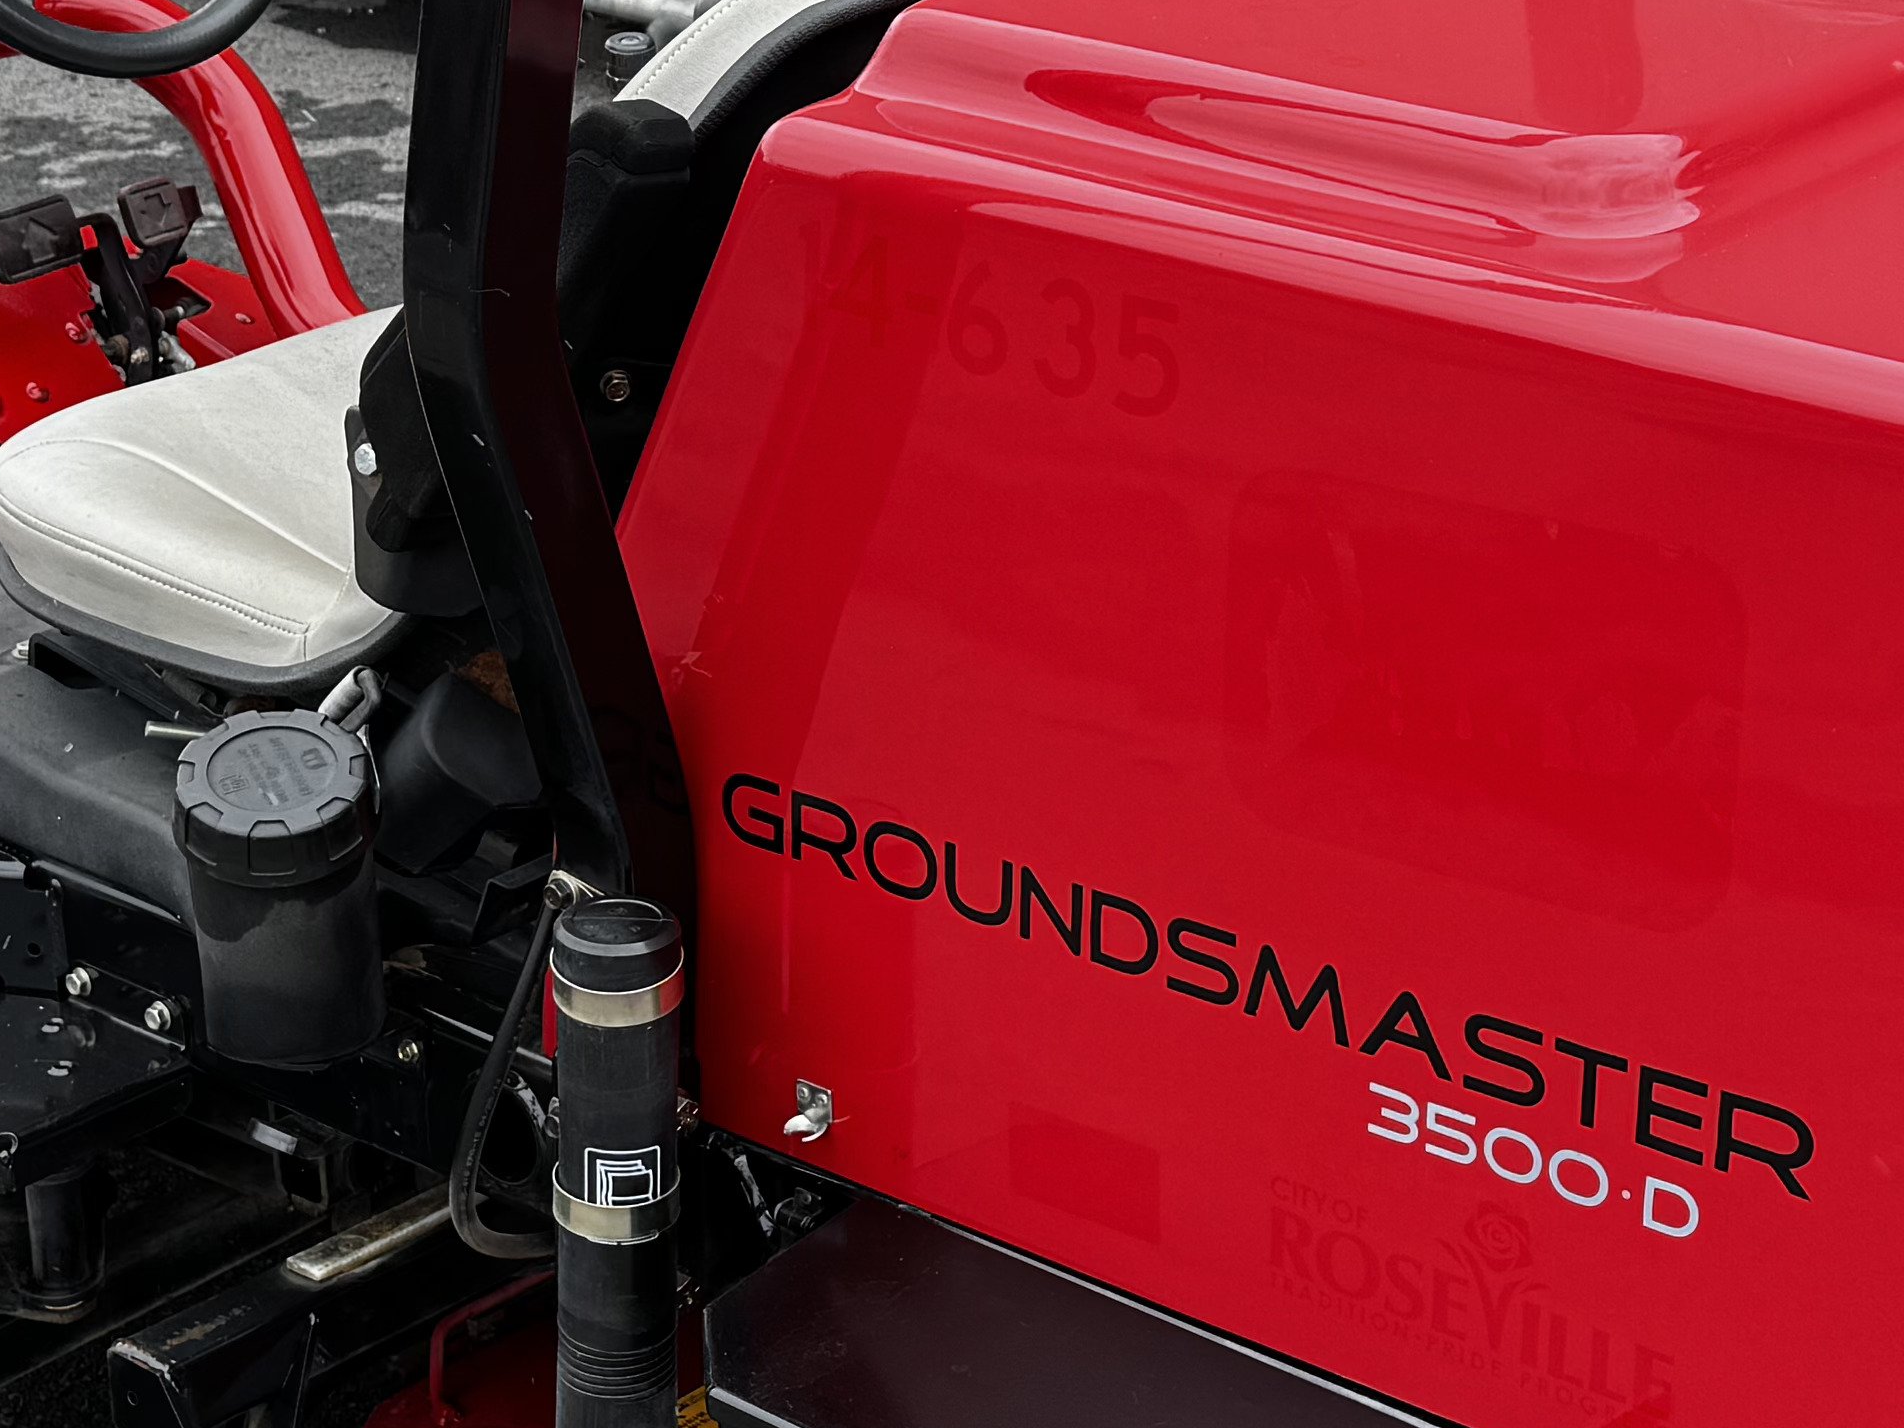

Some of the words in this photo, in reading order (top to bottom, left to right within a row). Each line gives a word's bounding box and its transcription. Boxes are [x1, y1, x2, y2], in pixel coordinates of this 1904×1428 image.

[720, 772, 1816, 1202] GROUNDSMASTER
[1269, 1174, 1329, 1214] CITY
[1331, 1198, 1369, 1231] OF
[1268, 1205, 1676, 1421] ROSEVILLE
